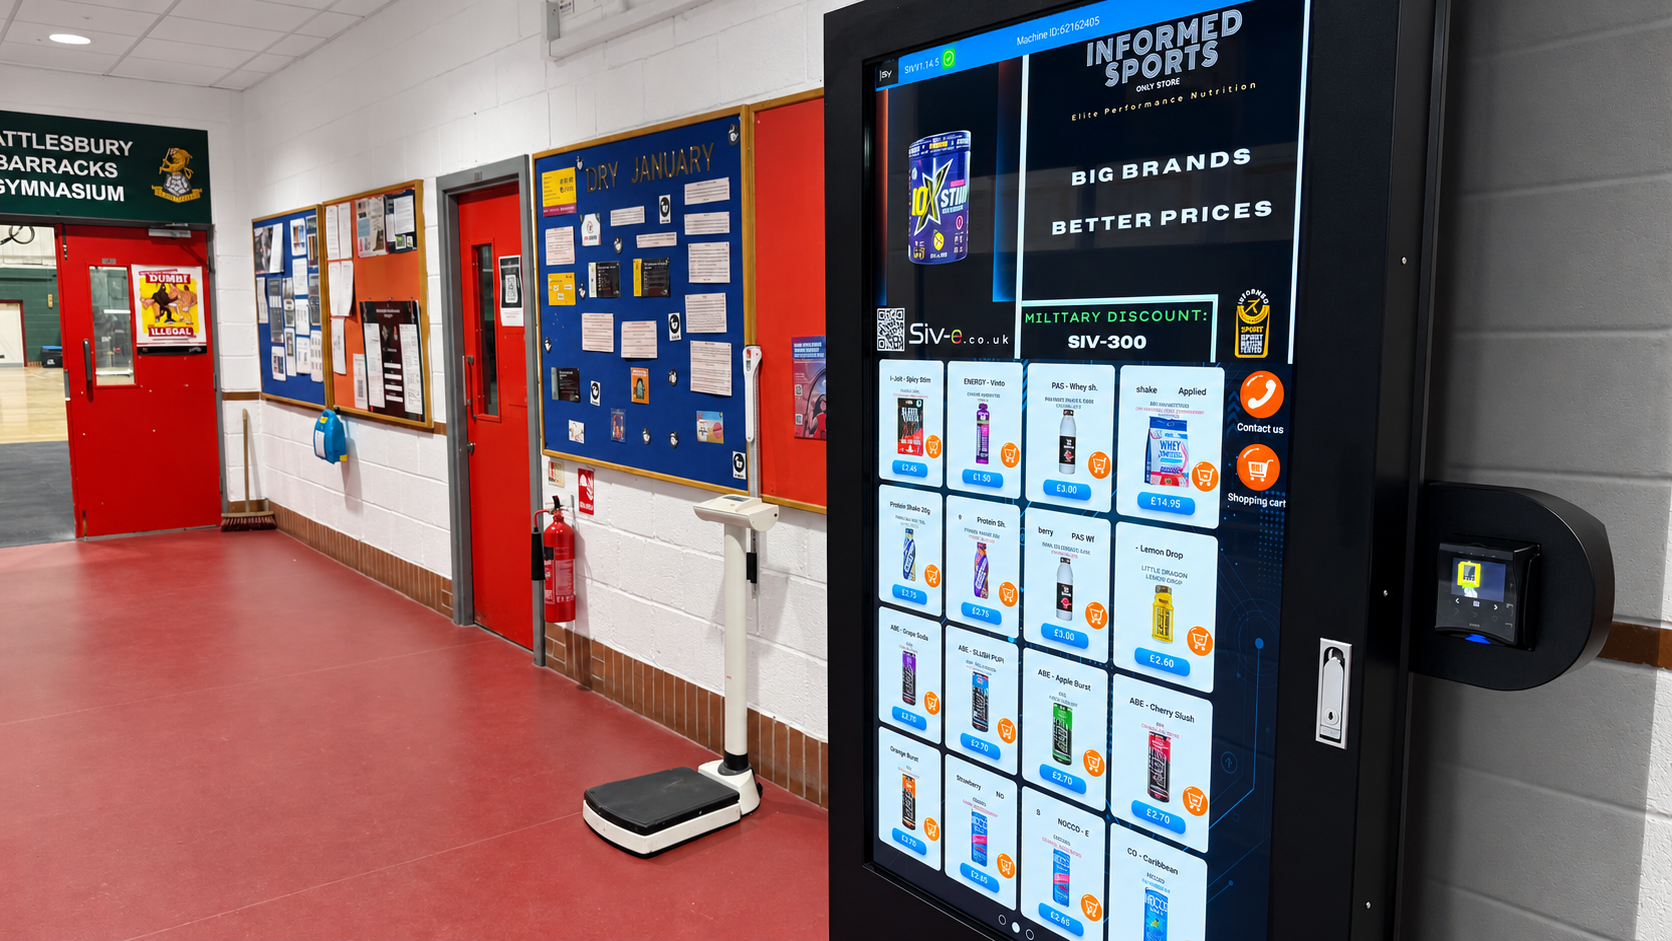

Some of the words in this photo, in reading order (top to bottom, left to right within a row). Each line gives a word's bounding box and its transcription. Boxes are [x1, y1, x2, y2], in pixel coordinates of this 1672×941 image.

[1016, 31, 1048, 46] Machine
[1049, 16, 1100, 37] ID:62162405
[1086, 9, 1243, 67] INFORMED
[1104, 40, 1219, 88] SPORTS
[1136, 83, 1155, 93] ONLY
[1156, 78, 1180, 89] STORE
[1071, 110, 1099, 122] Elite
[1104, 95, 1184, 115] Performance
[1190, 81, 1256, 99] Nutrition
[586, 161, 619, 193] DRY
[631, 143, 714, 183] JANUARY
[1071, 167, 1114, 186] BIG
[1122, 148, 1251, 180] BRANDS
[1051, 212, 1152, 235] BETTER
[1160, 200, 1272, 226] PRICES
[1107, 309, 1208, 323] DISCOUNT:
[1067, 335, 1147, 349] SIV-300
[1051, 381, 1065, 390] PAS
[1069, 383, 1087, 392] Whey
[1136, 386, 1158, 394] shake
[1178, 387, 1207, 397] Applied
[1237, 422, 1271, 433] Contact
[1273, 426, 1284, 434] us
[1056, 484, 1077, 495] £3.00
[1150, 496, 1181, 509] £14.95
[1227, 492, 1268, 507] Shopping
[1269, 498, 1286, 508] cart
[1038, 526, 1054, 538] berry
[1071, 532, 1085, 542] PAS
[1140, 544, 1165, 556] Lemon
[1165, 549, 1184, 560] Drop
[1149, 654, 1175, 668] £2.60
[1037, 668, 1051, 679] ABE
[1055, 674, 1074, 687] Apple
[1129, 697, 1145, 708] ABE
[1149, 703, 1174, 719] Cherry
[1174, 711, 1195, 724] Slush
[970, 739, 989, 752] £2.70
[1052, 770, 1073, 786] £2.70
[1146, 808, 1170, 825] £2.70
[1057, 817, 1081, 833] NOCCO
[1142, 854, 1179, 875] Caribbean
